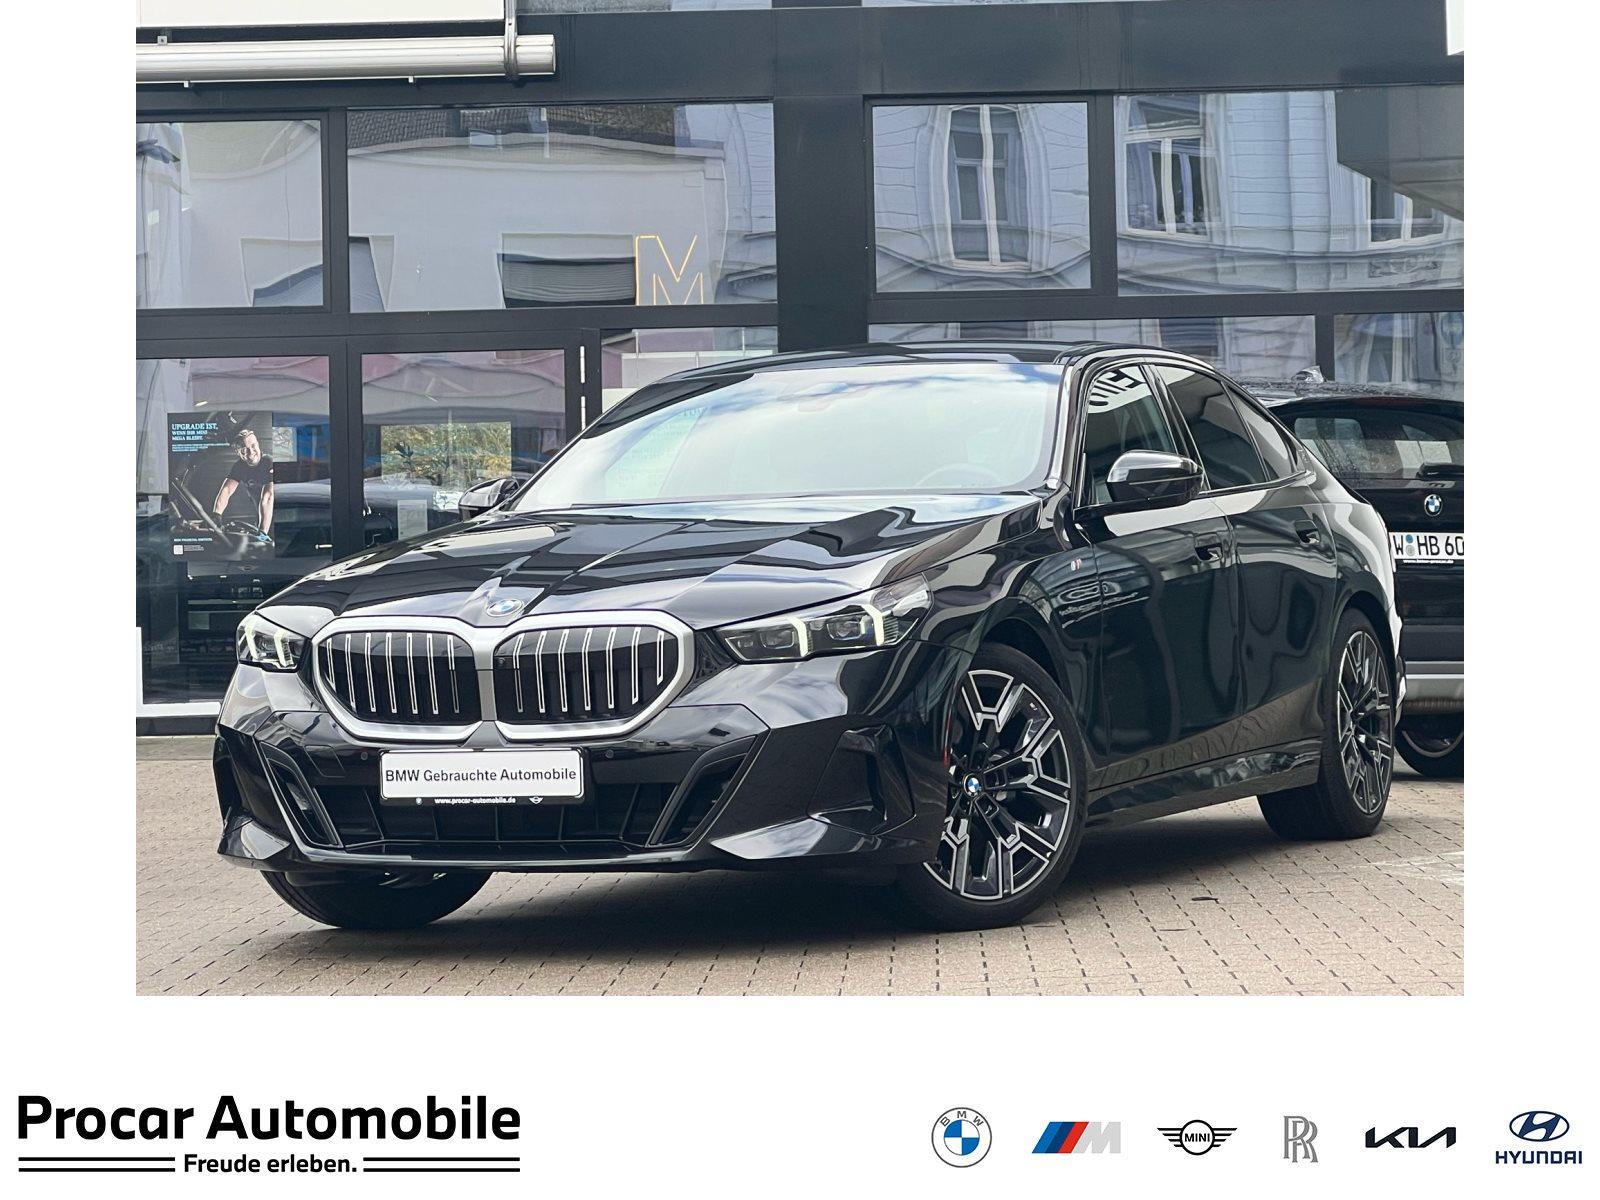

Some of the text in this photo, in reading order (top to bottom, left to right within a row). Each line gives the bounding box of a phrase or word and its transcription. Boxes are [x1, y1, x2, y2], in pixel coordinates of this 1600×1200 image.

[635, 234, 704, 305] M
[1393, 534, 1404, 556] W
[1416, 535, 1440, 556] HB
[385, 767, 577, 782] BMW Gebrauchte Automobile
[434, 797, 517, 805] www.procar-automobile.de
